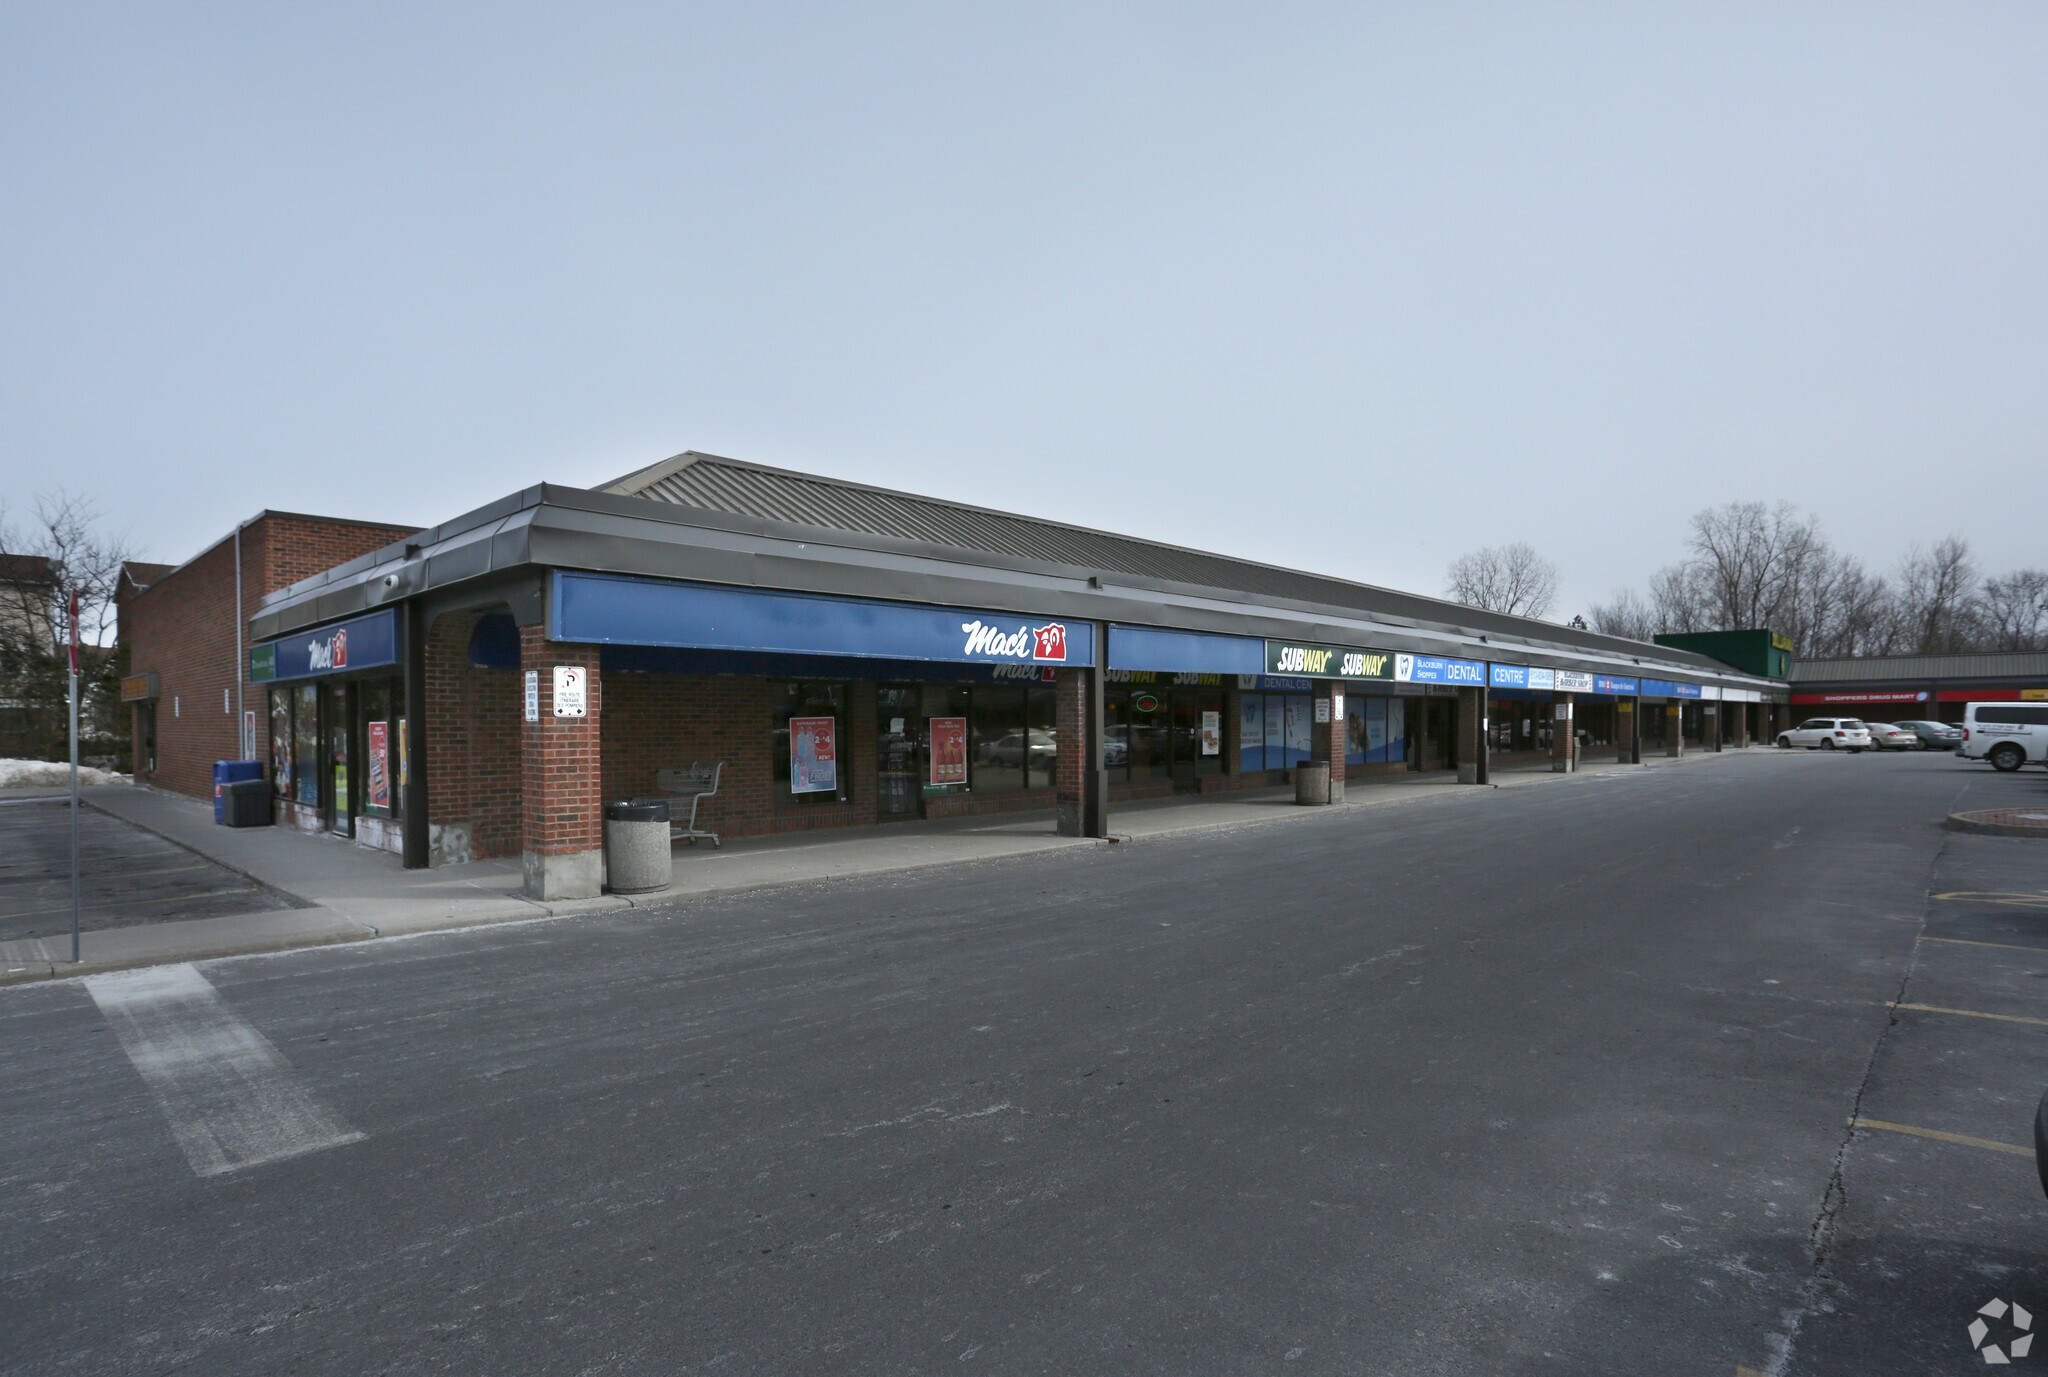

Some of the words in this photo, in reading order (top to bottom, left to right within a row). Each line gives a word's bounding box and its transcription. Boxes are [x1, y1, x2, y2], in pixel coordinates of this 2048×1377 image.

[962, 620, 1030, 658] Mac's
[1277, 647, 1333, 673] SUBWAY
[1340, 653, 1387, 676] SUBWAY
[1416, 660, 1443, 669] BLACKBURN
[1447, 664, 1482, 681] DENTAL
[1264, 678, 1295, 688] DENTAL
[1416, 670, 1437, 679] SHOPPES
[1494, 668, 1524, 684] CENTRE
